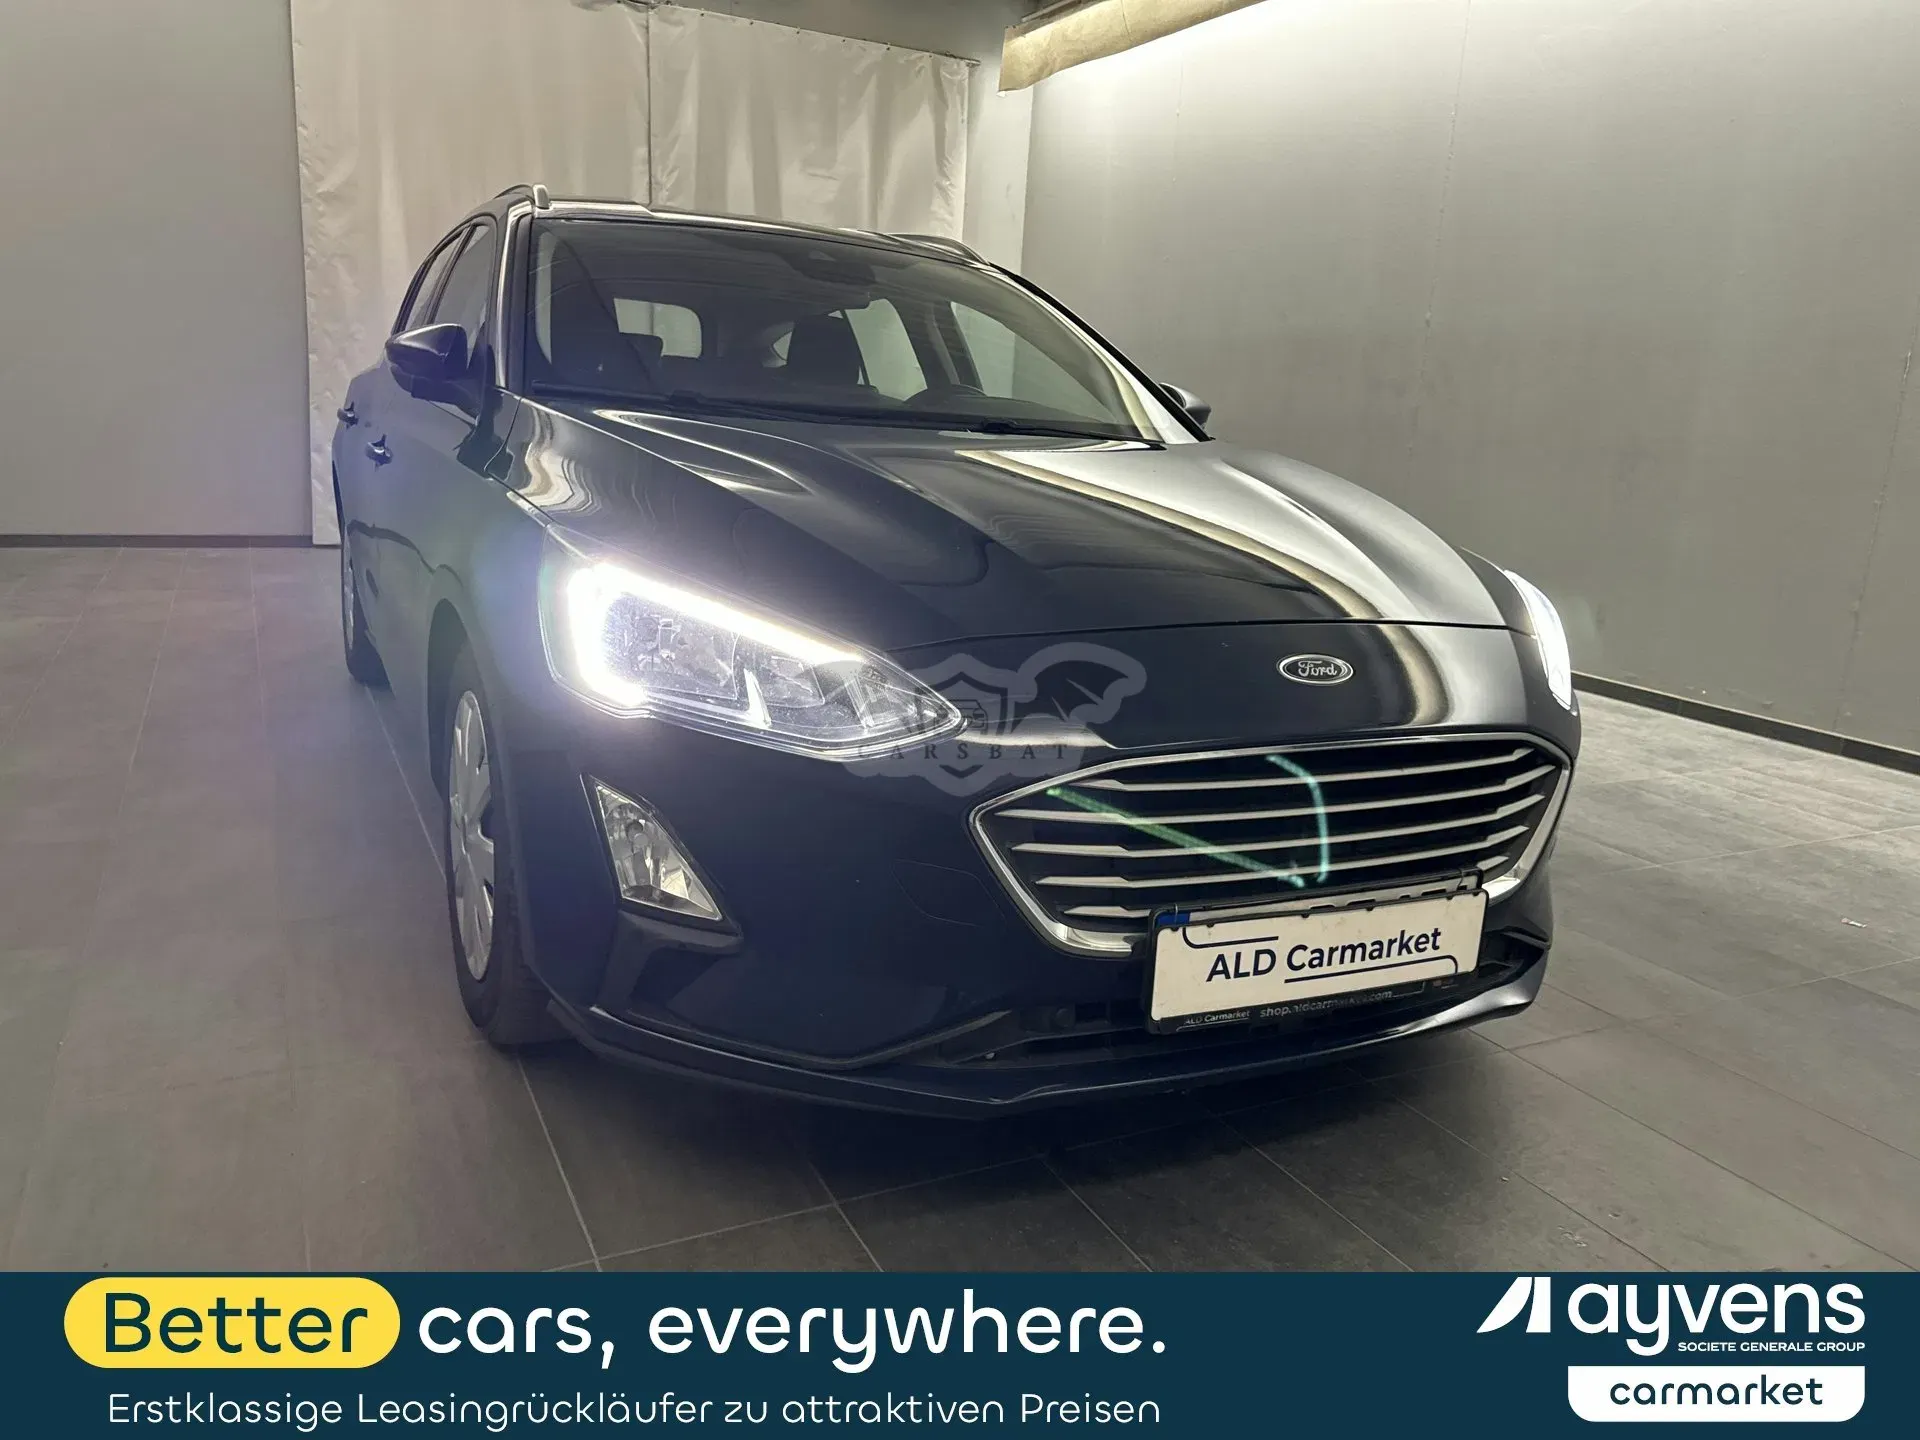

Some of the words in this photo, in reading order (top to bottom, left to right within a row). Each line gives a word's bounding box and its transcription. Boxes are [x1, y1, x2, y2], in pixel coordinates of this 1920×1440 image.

[1298, 660, 1338, 678] Ford
[1206, 950, 1277, 983] ALD
[1286, 927, 1441, 972] Carmarket
[1184, 1015, 1203, 1025] ALD
[1204, 1010, 1250, 1022] Carmarket
